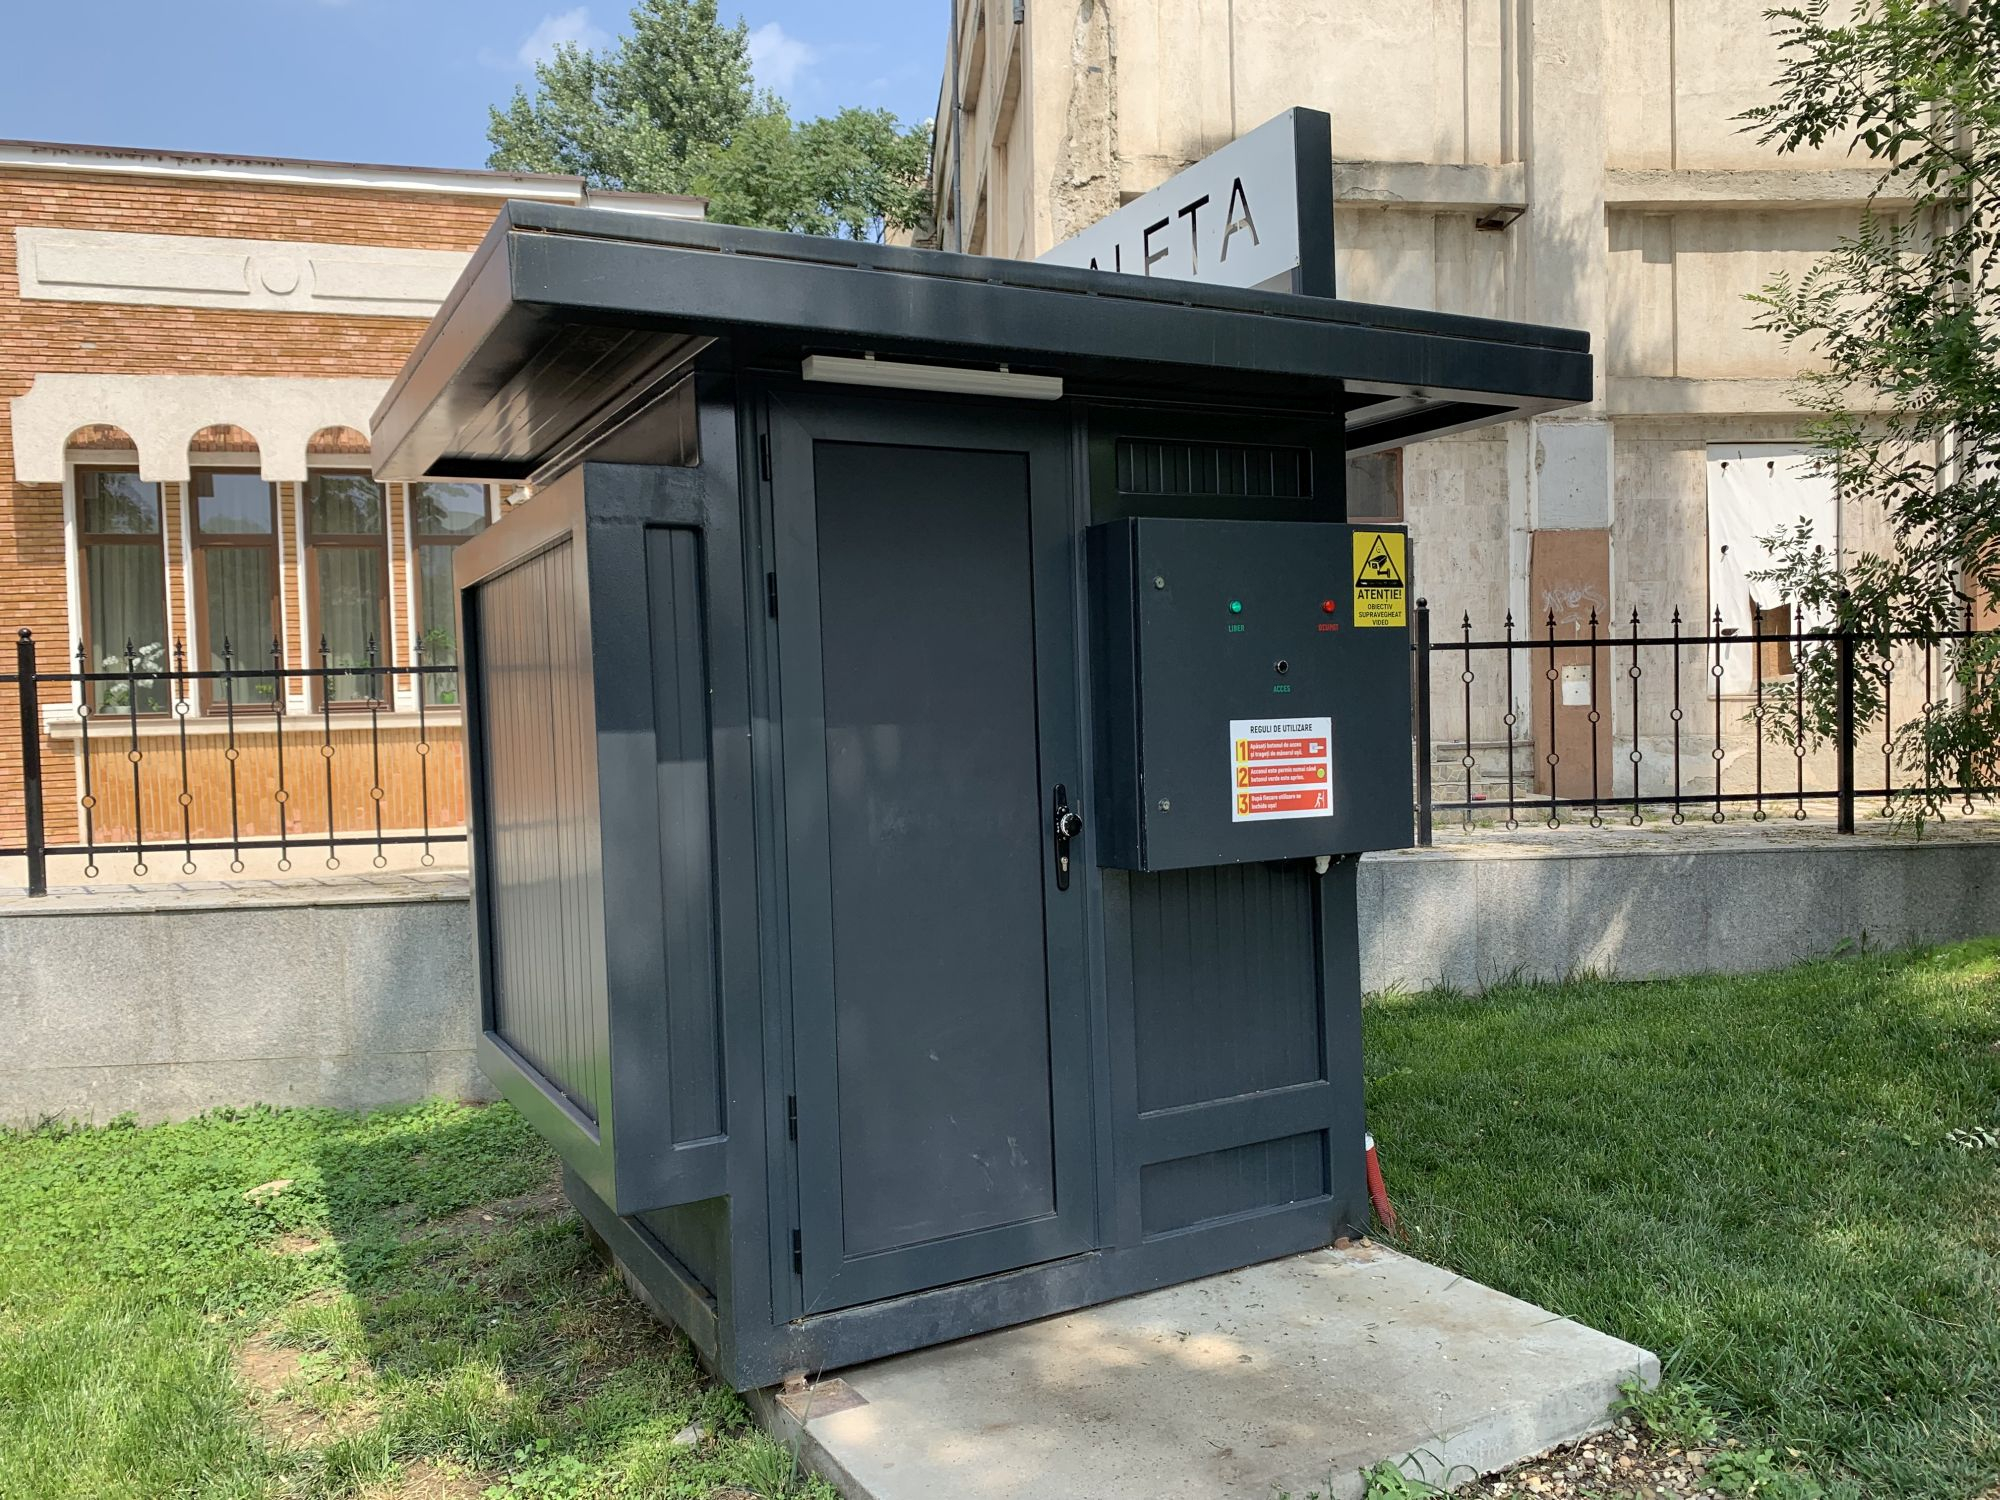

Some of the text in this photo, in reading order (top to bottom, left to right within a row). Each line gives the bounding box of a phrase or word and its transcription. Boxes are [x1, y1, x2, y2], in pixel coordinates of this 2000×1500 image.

[1357, 589, 1402, 602] ATENȚIE!
[1228, 624, 1245, 632] LIBER
[1273, 685, 1291, 693] ACCES
[1250, 723, 1313, 733] REGULI DE UTILIZARE
[1239, 741, 1246, 761] 1
[1239, 767, 1248, 787] 2
[1239, 793, 1249, 814] 3
